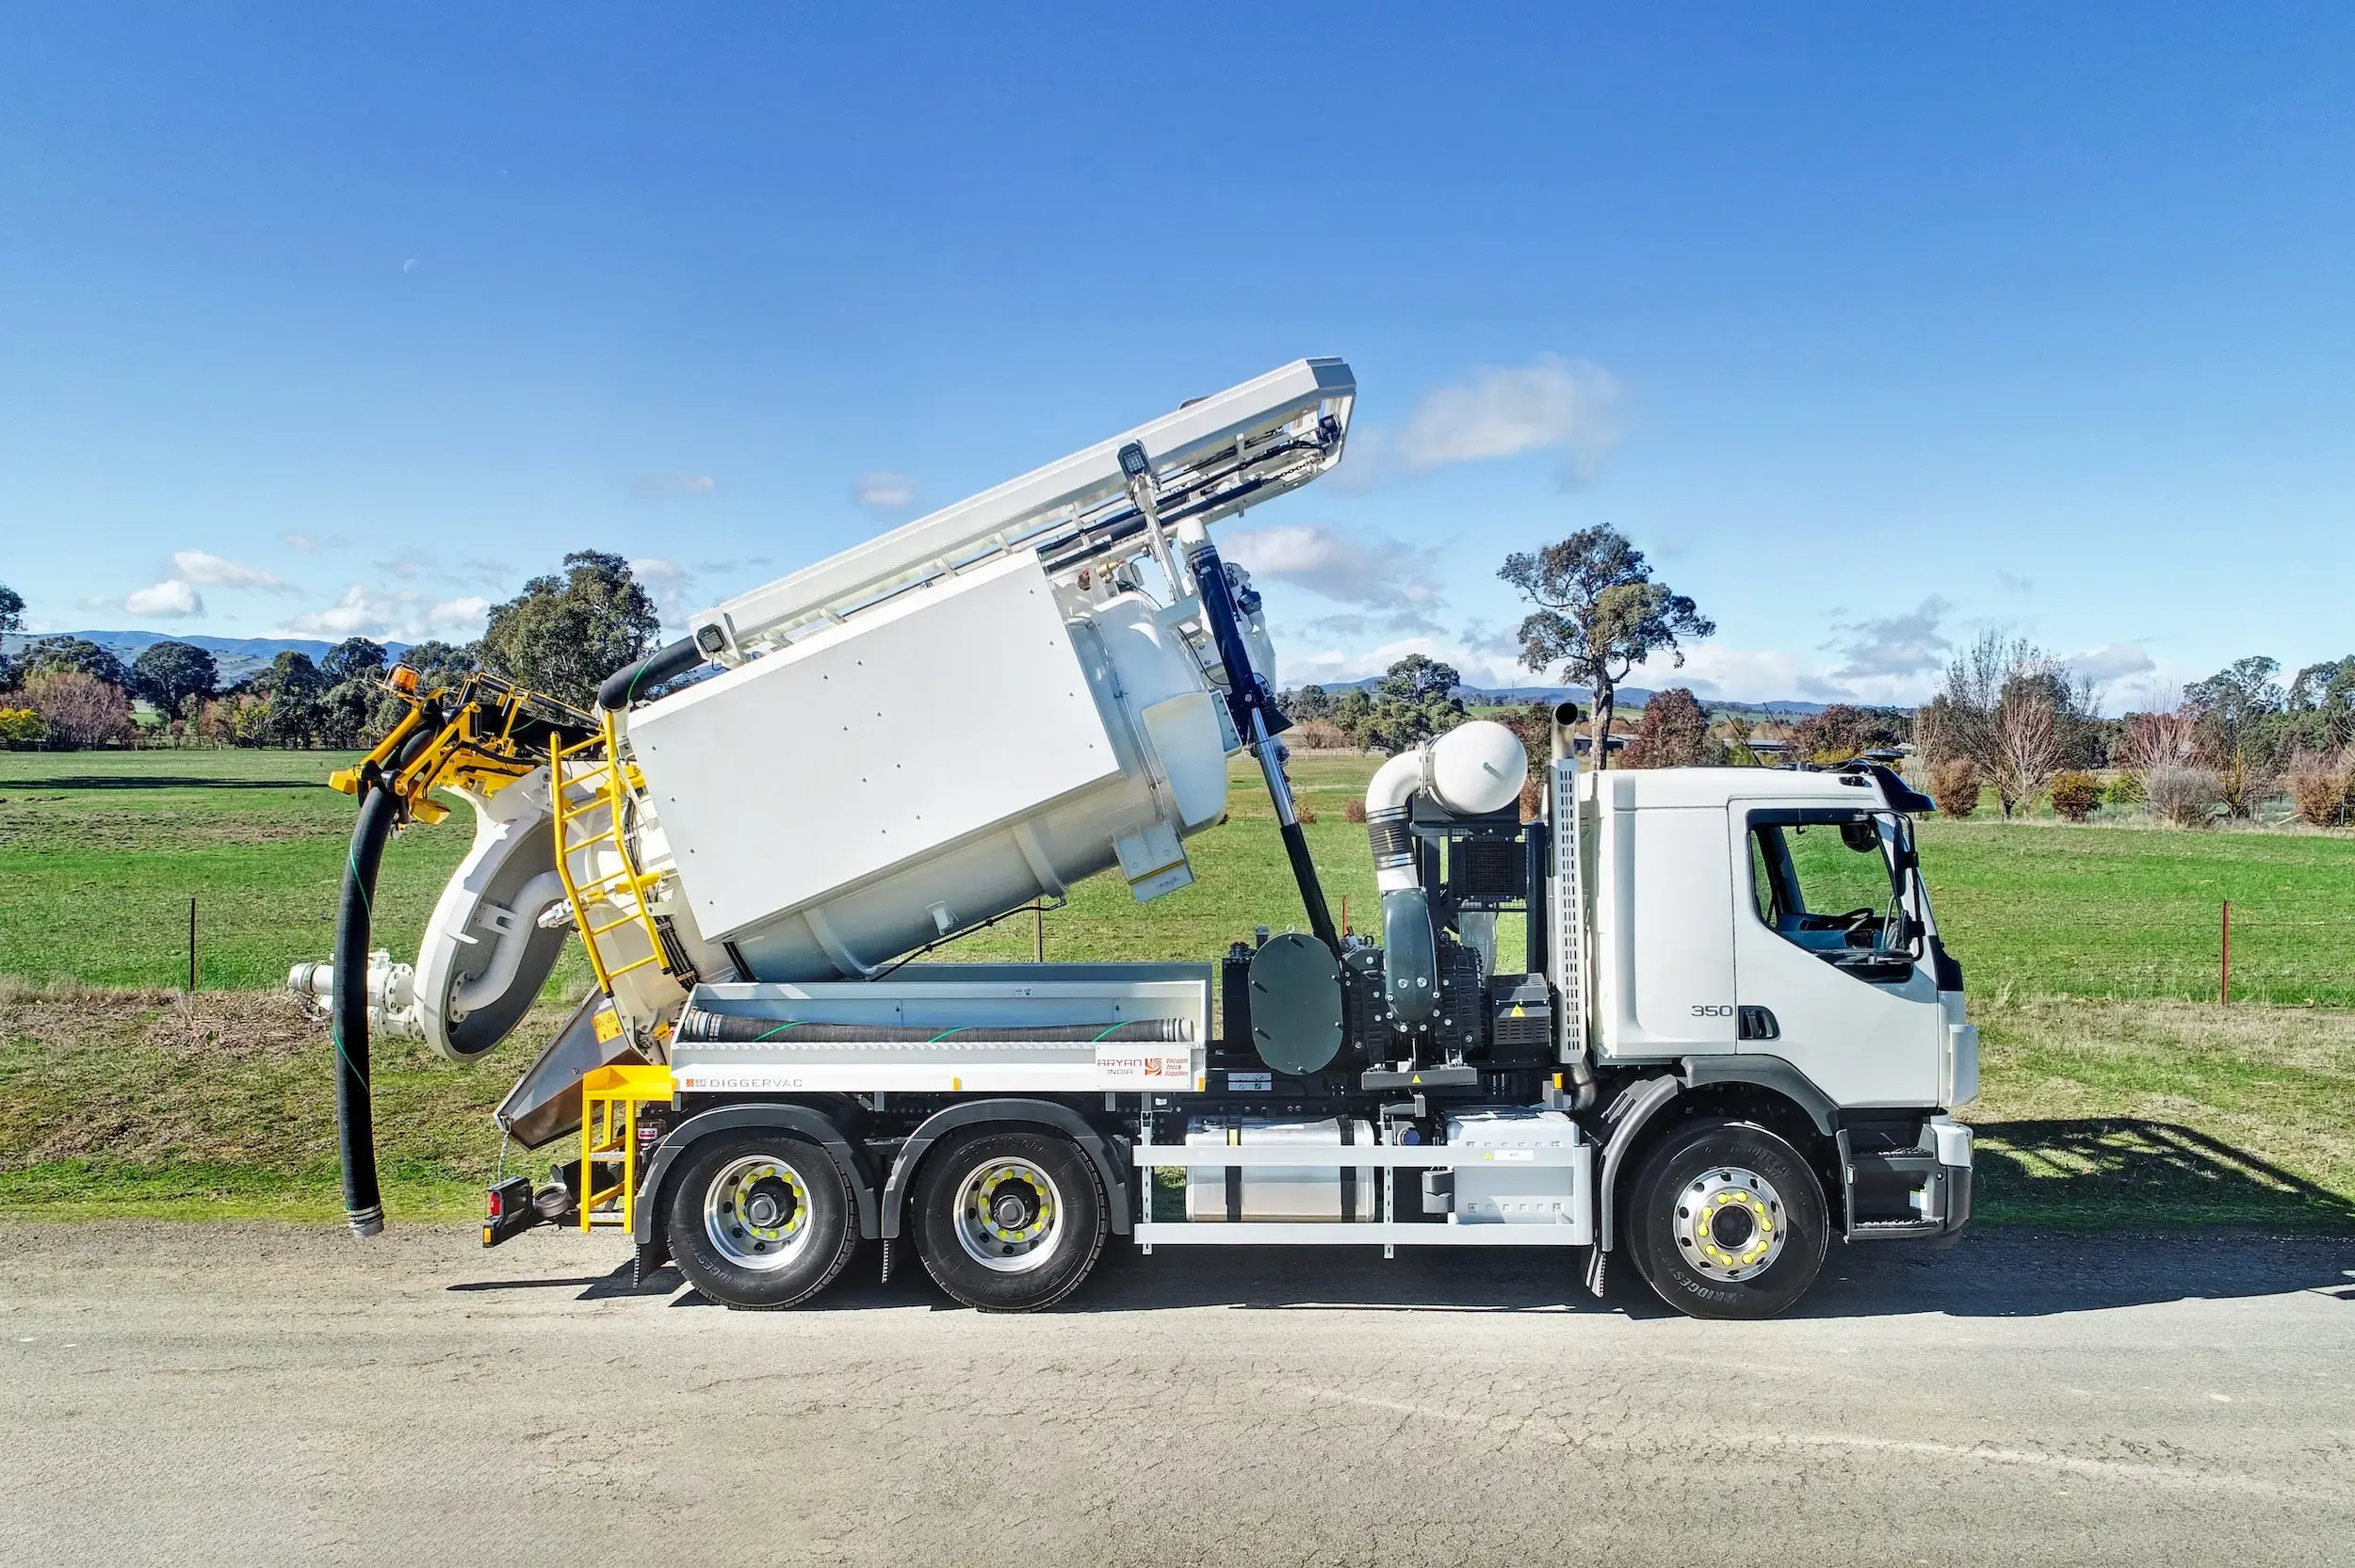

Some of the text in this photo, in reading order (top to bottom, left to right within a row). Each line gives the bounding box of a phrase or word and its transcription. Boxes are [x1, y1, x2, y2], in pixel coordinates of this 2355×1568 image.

[1691, 1005, 1733, 1017] 350
[1097, 1059, 1142, 1067] ARYAN
[709, 1078, 804, 1088] DIGGERVAC
